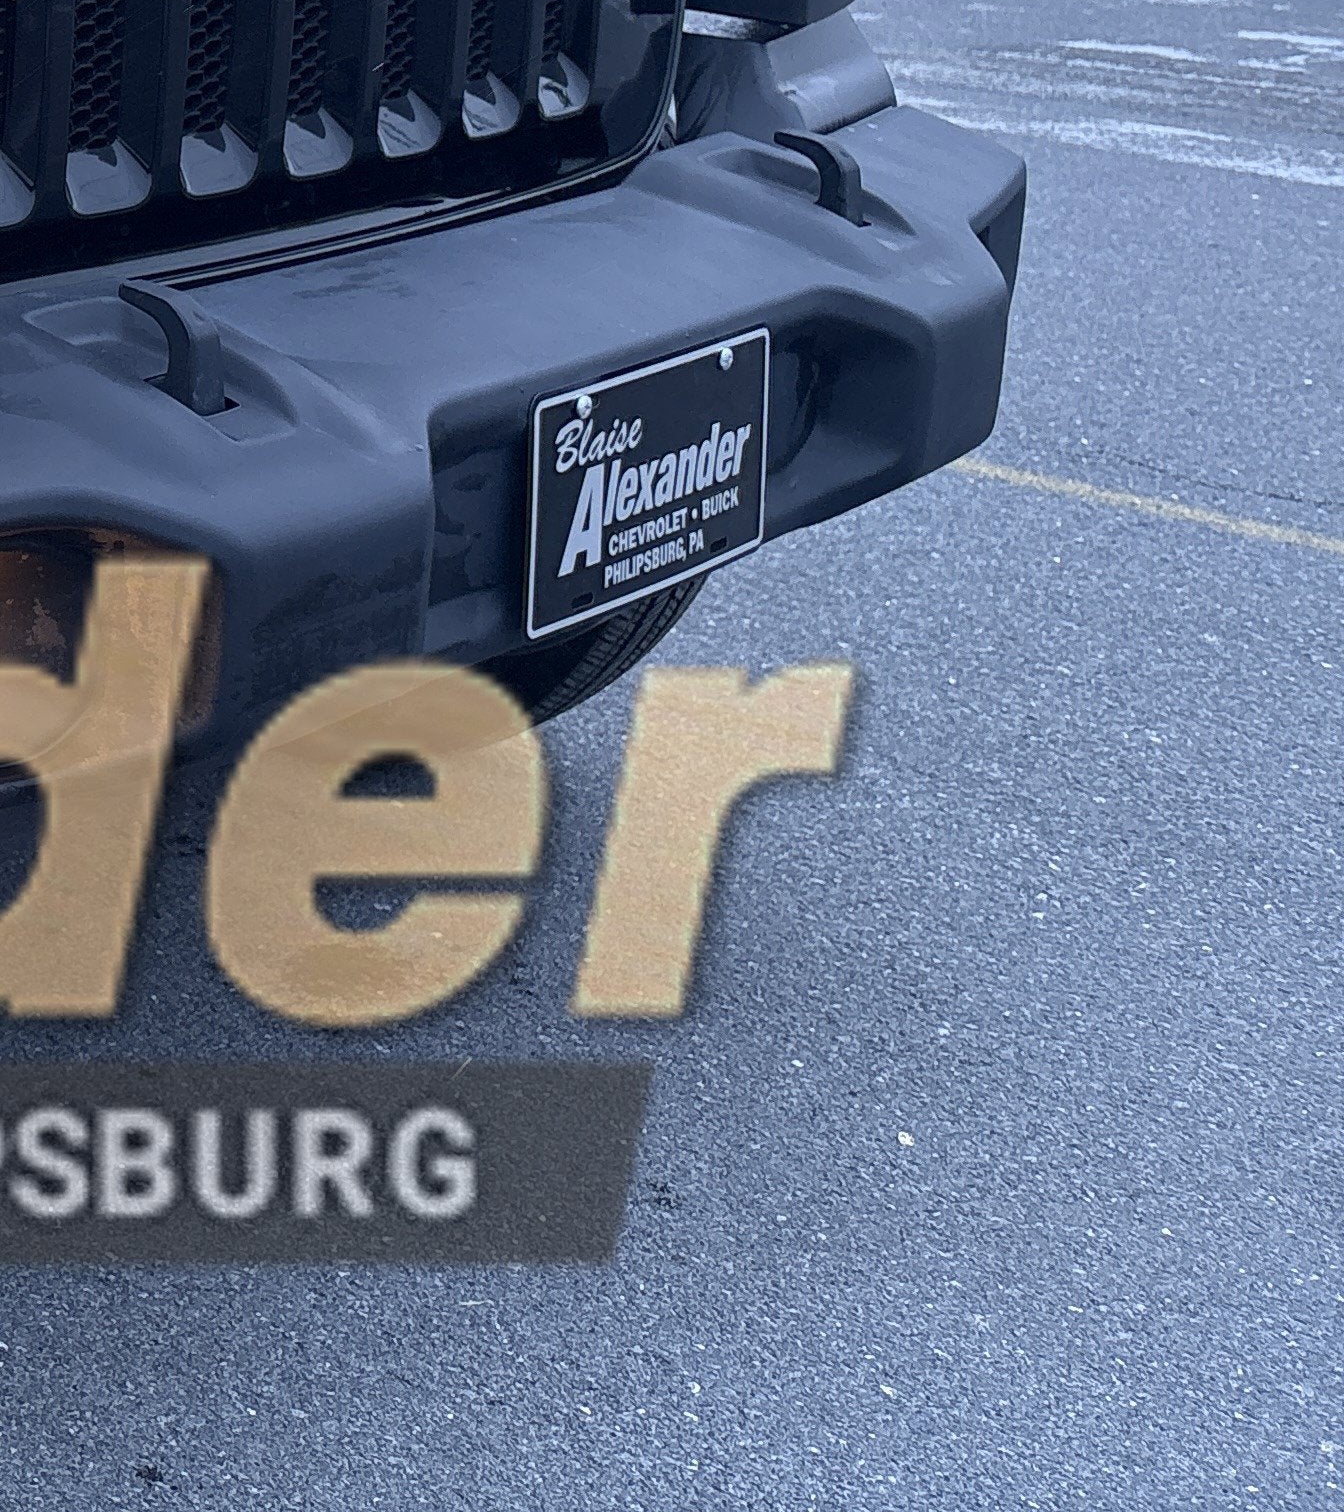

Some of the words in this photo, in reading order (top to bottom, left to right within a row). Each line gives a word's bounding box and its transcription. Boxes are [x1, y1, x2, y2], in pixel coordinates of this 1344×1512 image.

[555, 417, 643, 474] Blaise
[556, 422, 752, 578] Alexander
[608, 508, 687, 557] CHEVROLET
[701, 486, 739, 521] BUICK
[688, 528, 704, 554] PA
